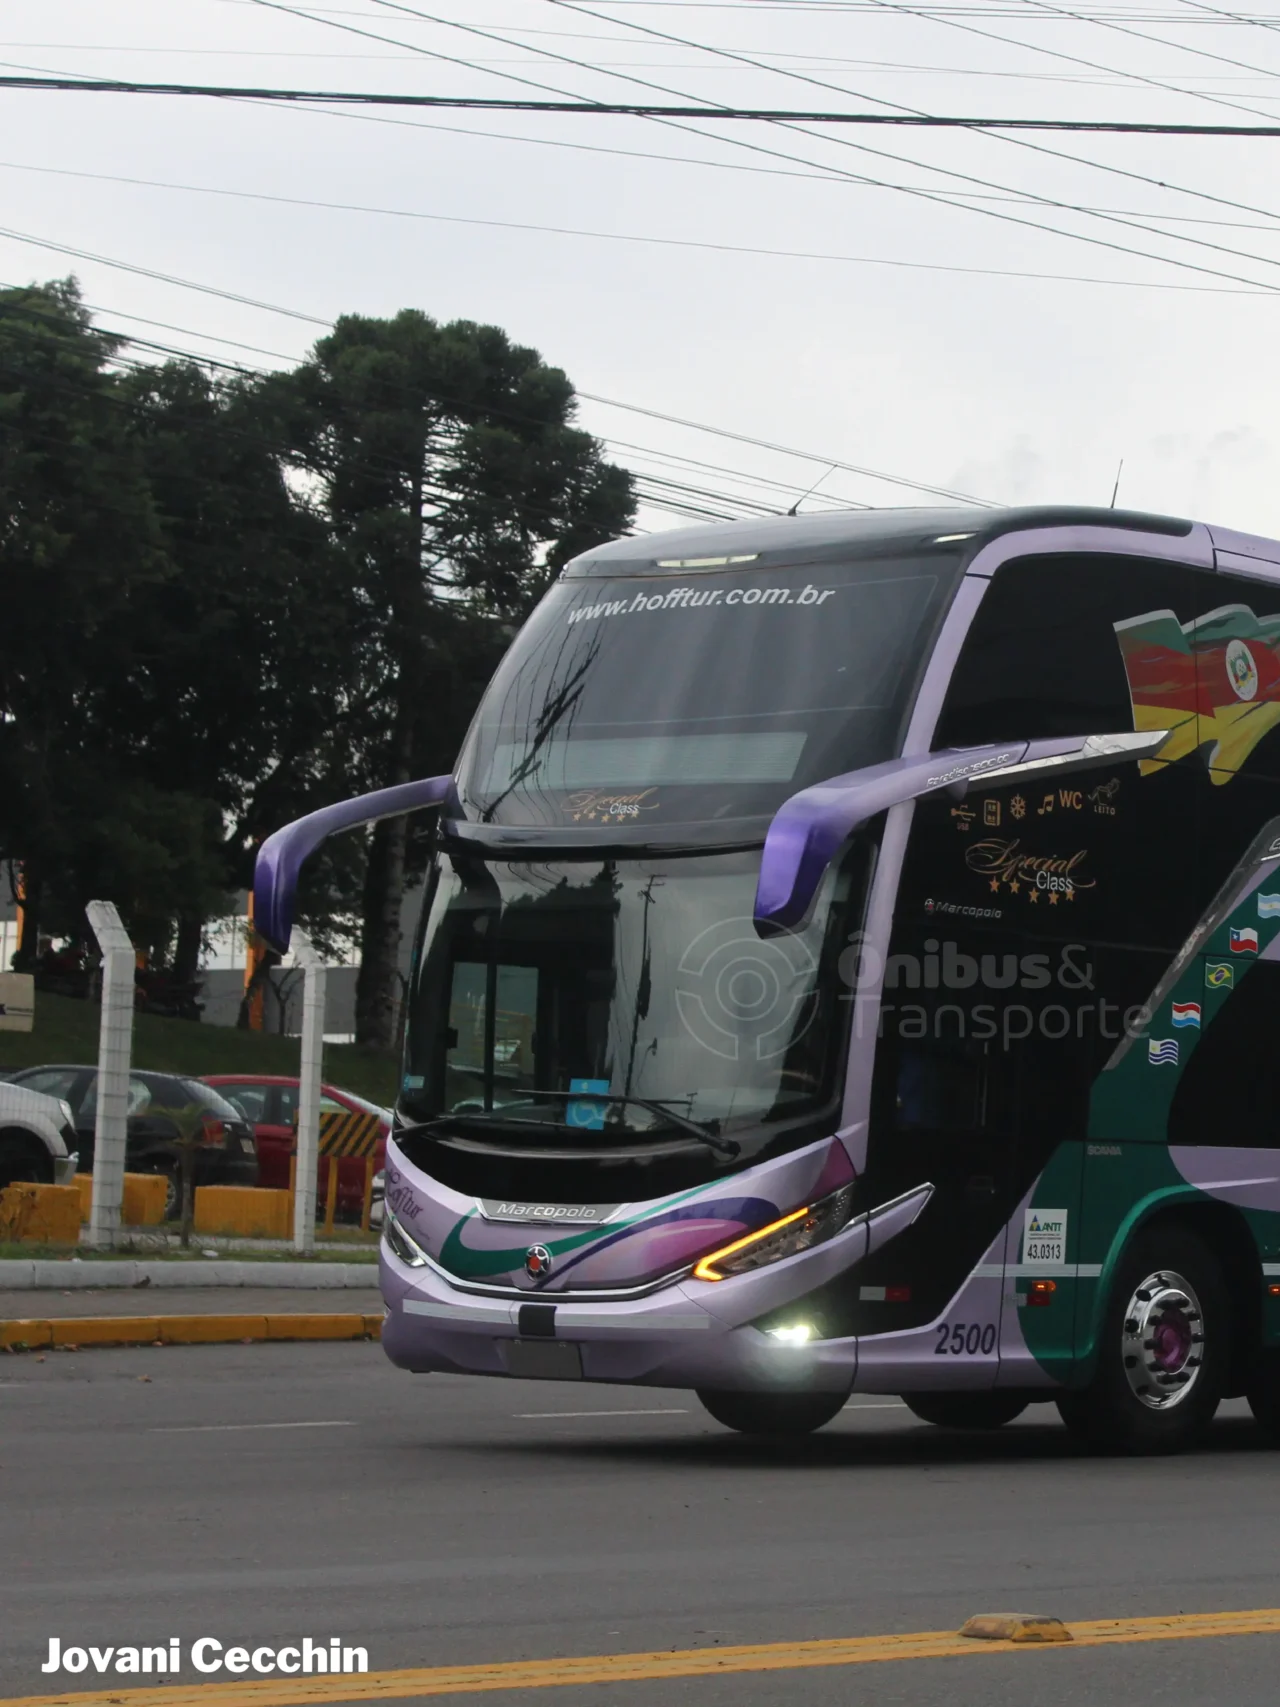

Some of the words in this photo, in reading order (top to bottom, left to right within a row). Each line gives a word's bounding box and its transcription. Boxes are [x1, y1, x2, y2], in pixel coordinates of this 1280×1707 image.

[567, 585, 835, 624] www.hofftur.com.br
[1059, 789, 1083, 810] WC
[609, 803, 640, 815] Class
[1094, 804, 1117, 816] LEITO
[965, 838, 1096, 882] Special
[1036, 870, 1074, 892] Class
[935, 902, 1002, 919] Marcopolo
[496, 1203, 597, 1219] Marcopolo
[1042, 1222, 1062, 1232] ANTT
[1027, 1243, 1061, 1260] 43.0313
[934, 1323, 996, 1355] 2500
